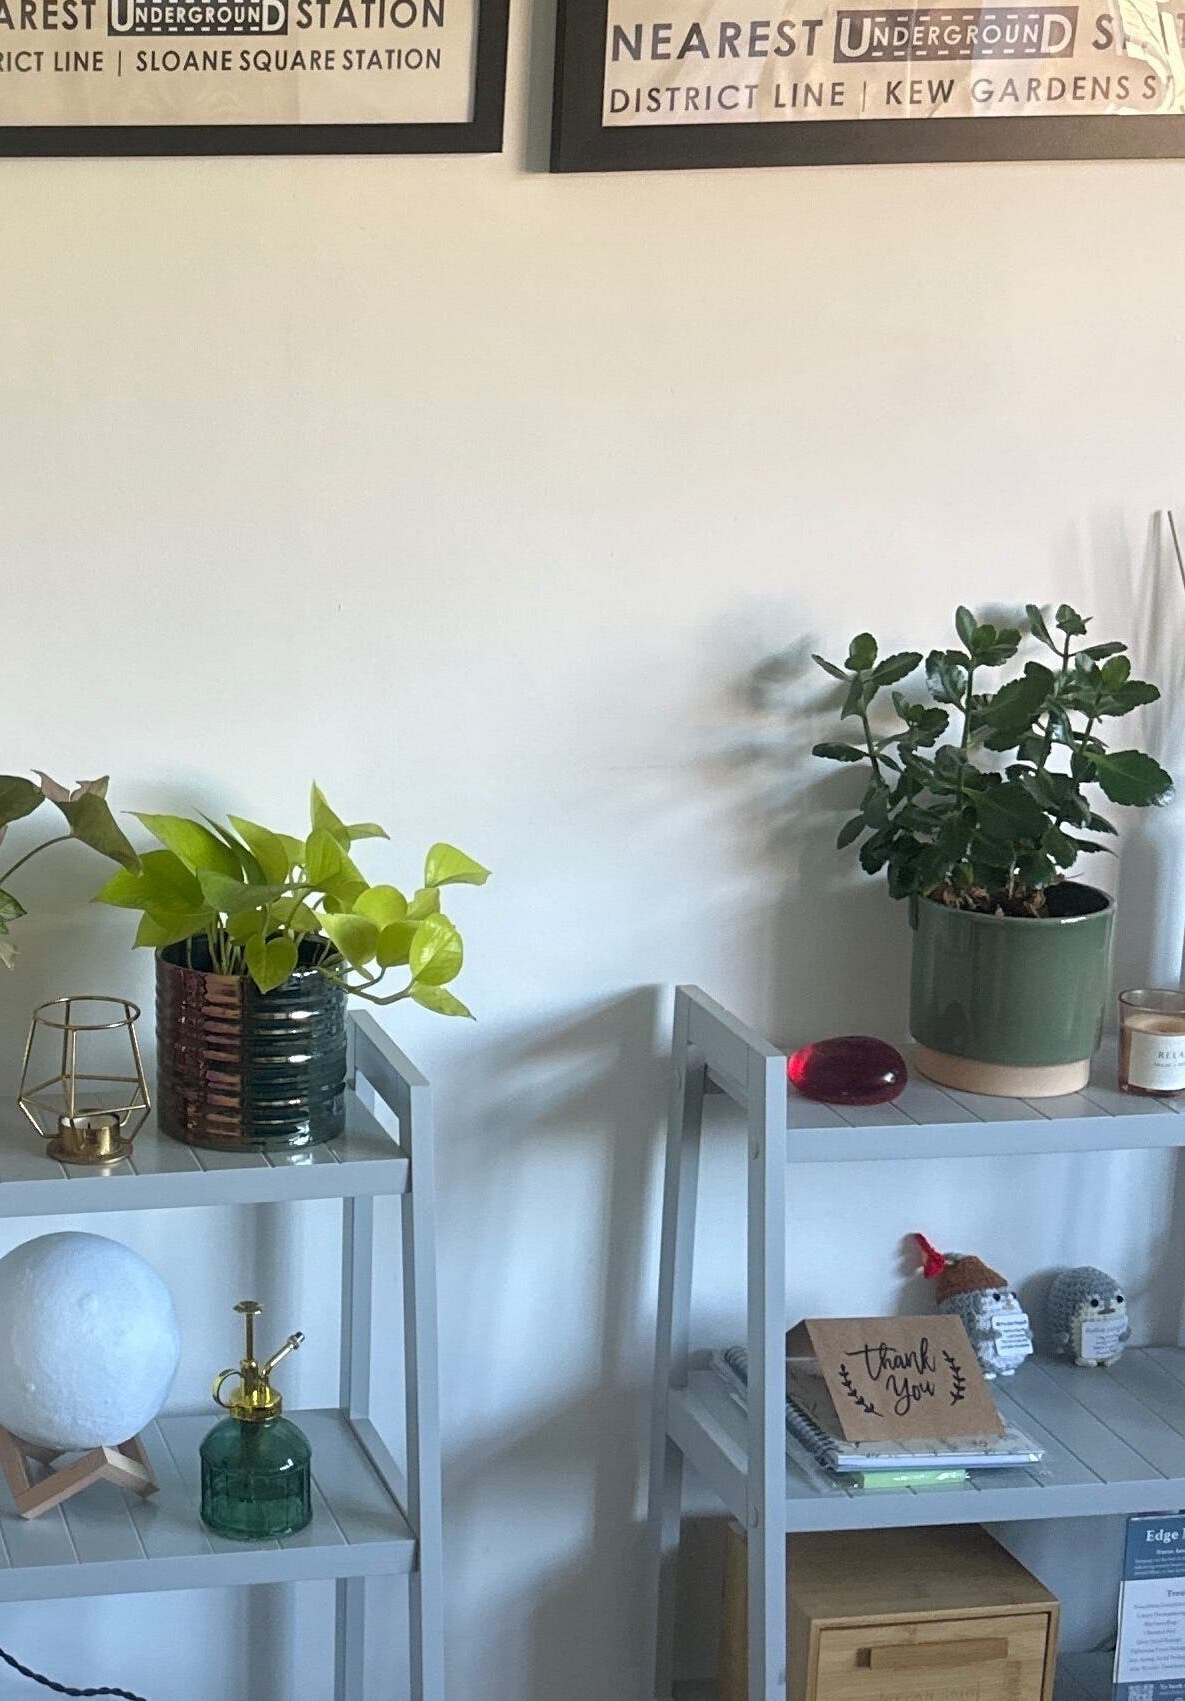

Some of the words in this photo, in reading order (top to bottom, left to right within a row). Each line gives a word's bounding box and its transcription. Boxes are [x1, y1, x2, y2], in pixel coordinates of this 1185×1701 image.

[110, 0, 286, 33] UNDERGROUND
[296, 0, 444, 29] STATION
[611, 19, 823, 62] NEAREST
[839, 14, 1073, 58] UNDERGROUND
[54, 51, 104, 72] LINE
[136, 50, 232, 72] SLOANE
[239, 49, 335, 72] SQUARE
[342, 48, 441, 71] STATION
[610, 84, 759, 113] DISTRICT
[774, 82, 845, 108] LINE
[885, 79, 955, 105] KEW
[971, 75, 1130, 103] GARDENS
[1146, 1528, 1179, 1543] Edge
